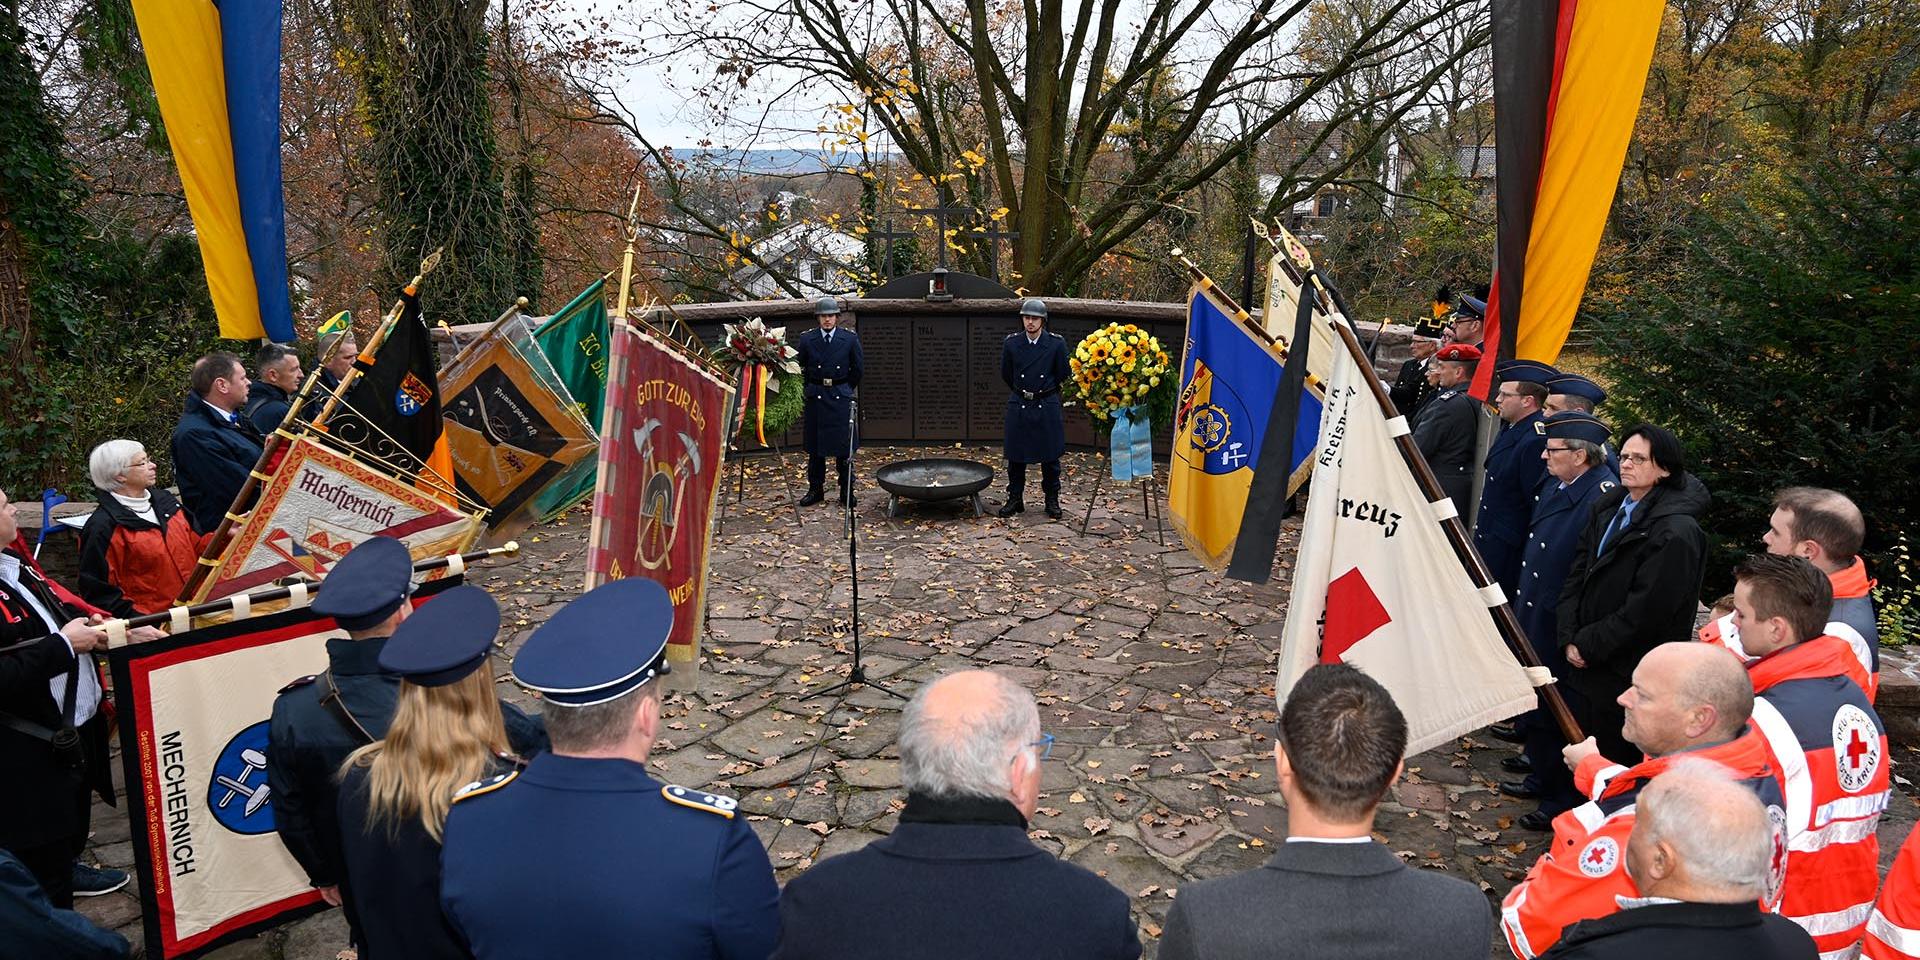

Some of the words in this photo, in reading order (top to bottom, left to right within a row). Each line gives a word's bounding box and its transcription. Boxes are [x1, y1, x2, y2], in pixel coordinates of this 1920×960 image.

[579, 332, 601, 357] KC
[637, 379, 665, 406] GOTT
[666, 382, 691, 412] ZUR
[299, 467, 396, 528] Mechernich
[1336, 497, 1402, 539] reuz
[146, 779, 155, 793] von
[147, 793, 158, 807] der
[161, 730, 196, 877] MECHERNICH
